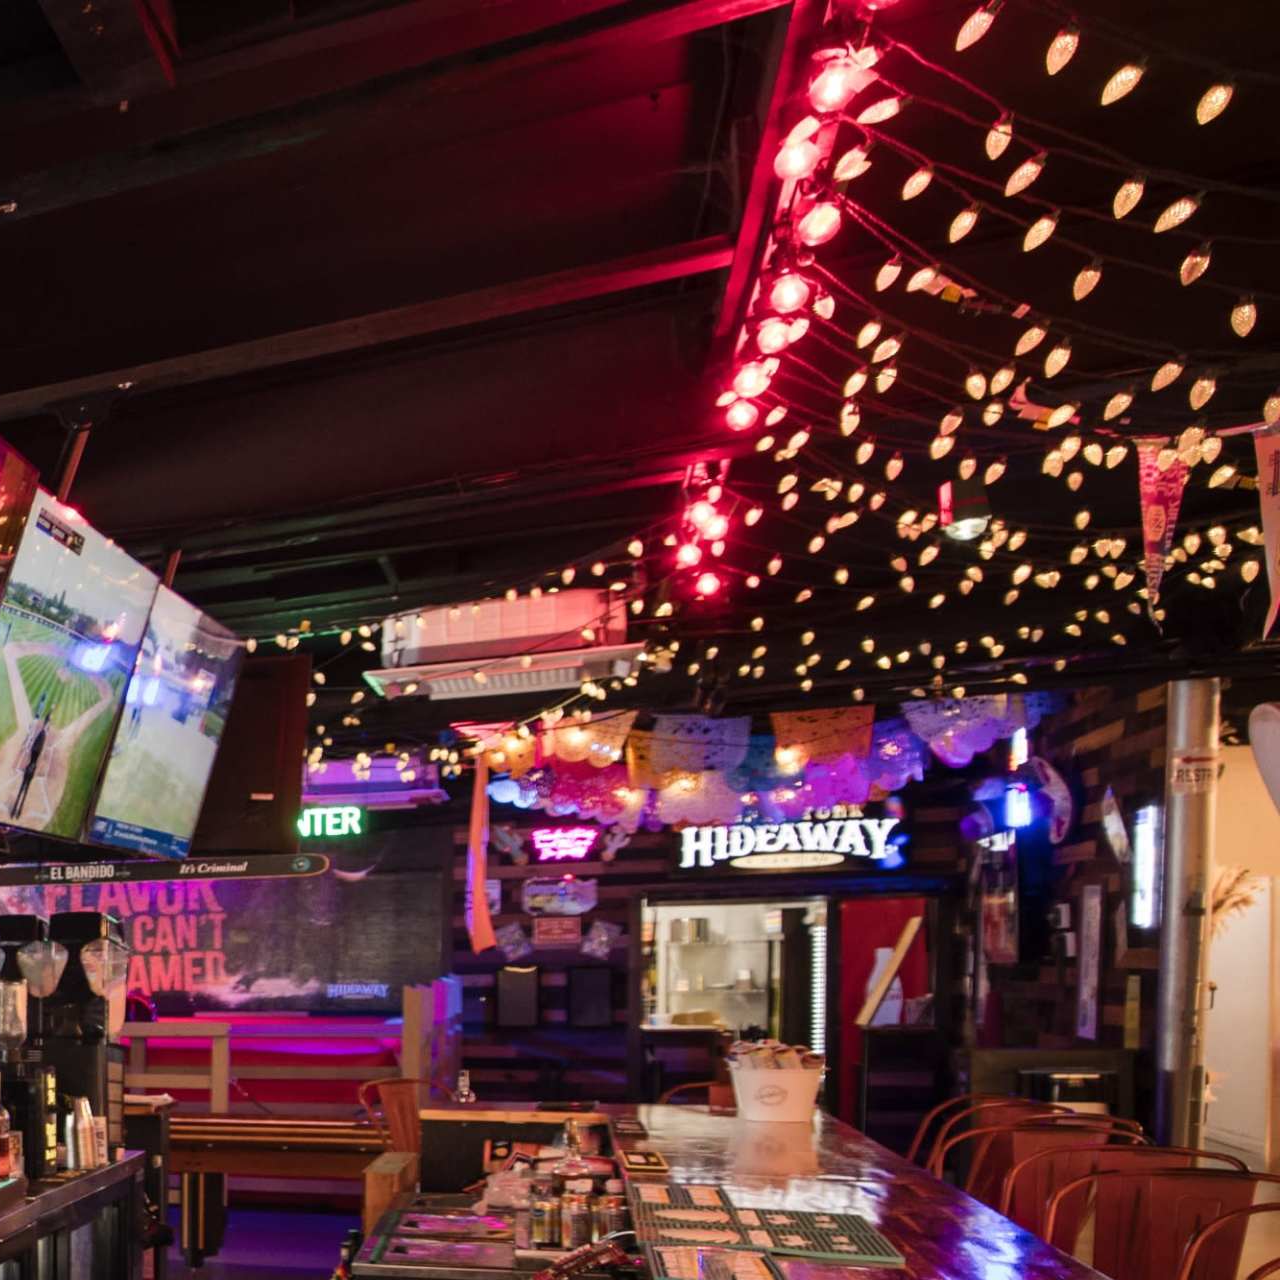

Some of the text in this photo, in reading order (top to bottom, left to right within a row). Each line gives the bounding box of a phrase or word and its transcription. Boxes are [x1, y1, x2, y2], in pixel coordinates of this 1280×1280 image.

[297, 806, 361, 838] NTER
[679, 818, 901, 868] HIDEAWAY
[50, 865, 114, 880] EL BANDIDO
[179, 861, 248, 875] It's Criminal
[133, 913, 227, 955] CAN'T
[127, 950, 227, 997] AMED
[327, 983, 391, 998] HIDEAWAY
